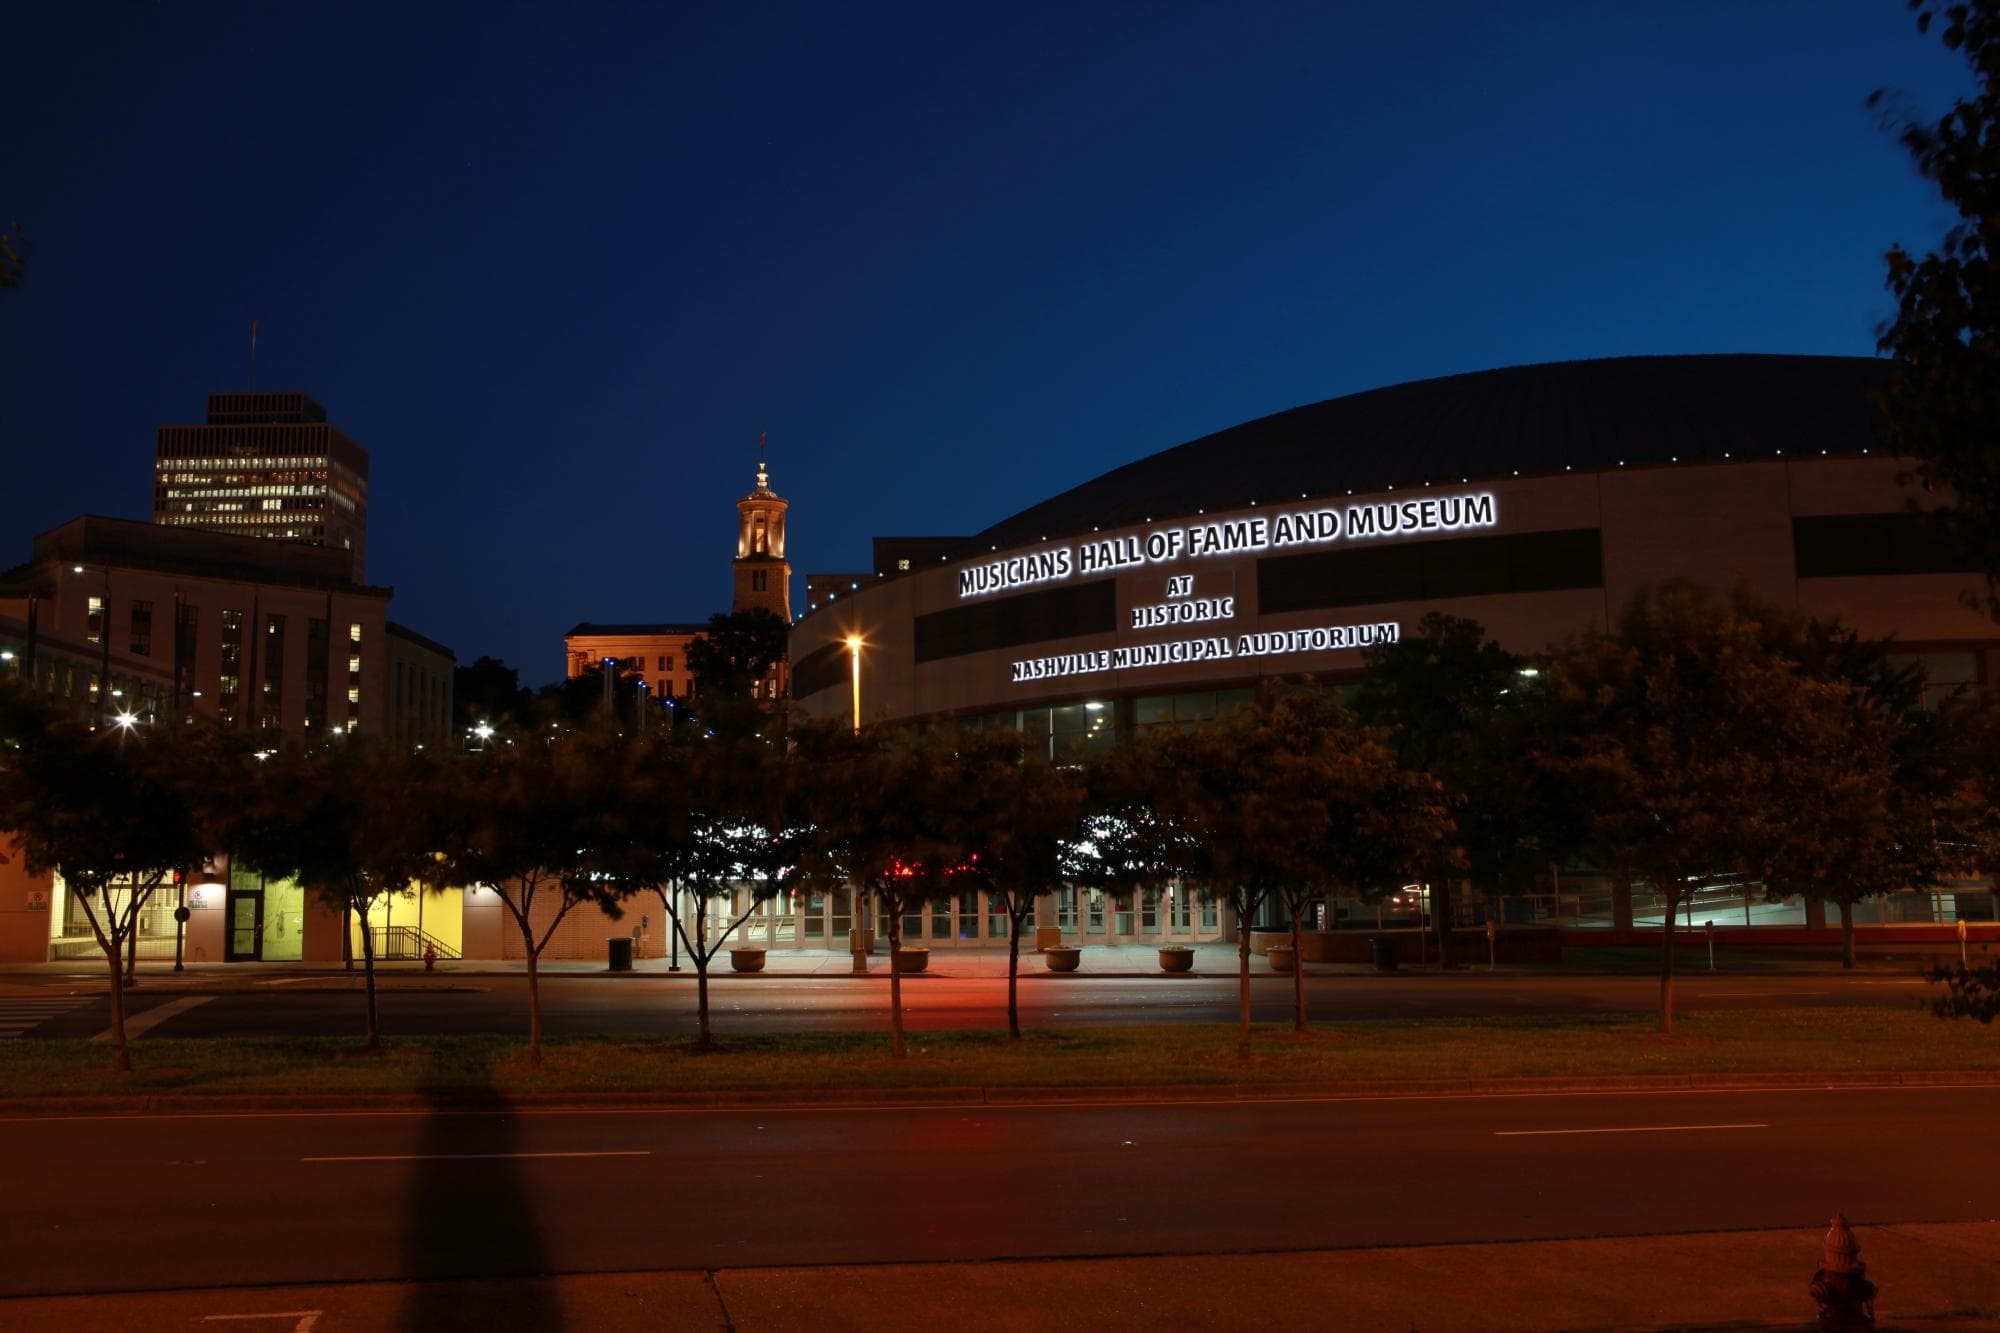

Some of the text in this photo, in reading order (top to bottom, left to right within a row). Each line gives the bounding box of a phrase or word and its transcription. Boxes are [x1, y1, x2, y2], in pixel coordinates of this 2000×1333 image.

[958, 496, 1493, 596] MUSICIANS HALL OF FAME AND MUSEUM
[1167, 576, 1193, 596] AT
[1131, 599, 1234, 628] HISTORIC
[1011, 623, 1398, 681] NASHVILLE MUNICIPAL AUDITORIUM
